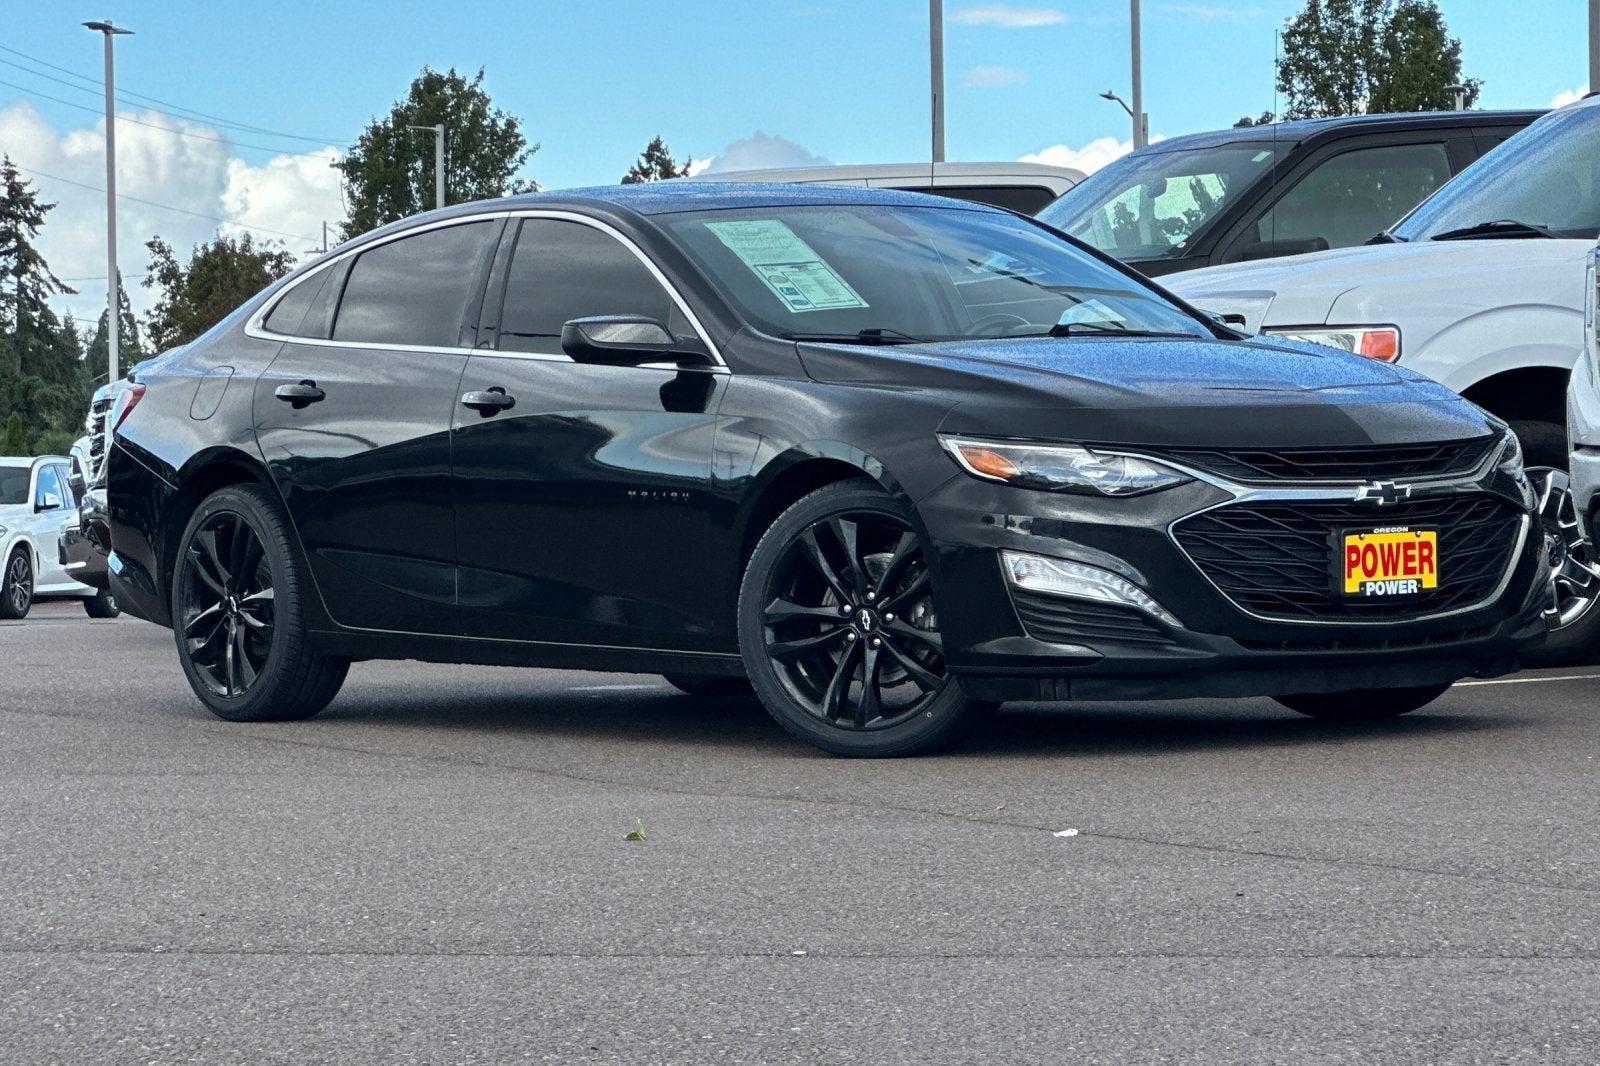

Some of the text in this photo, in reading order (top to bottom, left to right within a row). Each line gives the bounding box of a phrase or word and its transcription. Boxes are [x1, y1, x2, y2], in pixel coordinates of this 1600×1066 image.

[1373, 526, 1409, 534] OREGON
[1346, 540, 1434, 579] POWER
[1366, 579, 1418, 596] POWER
